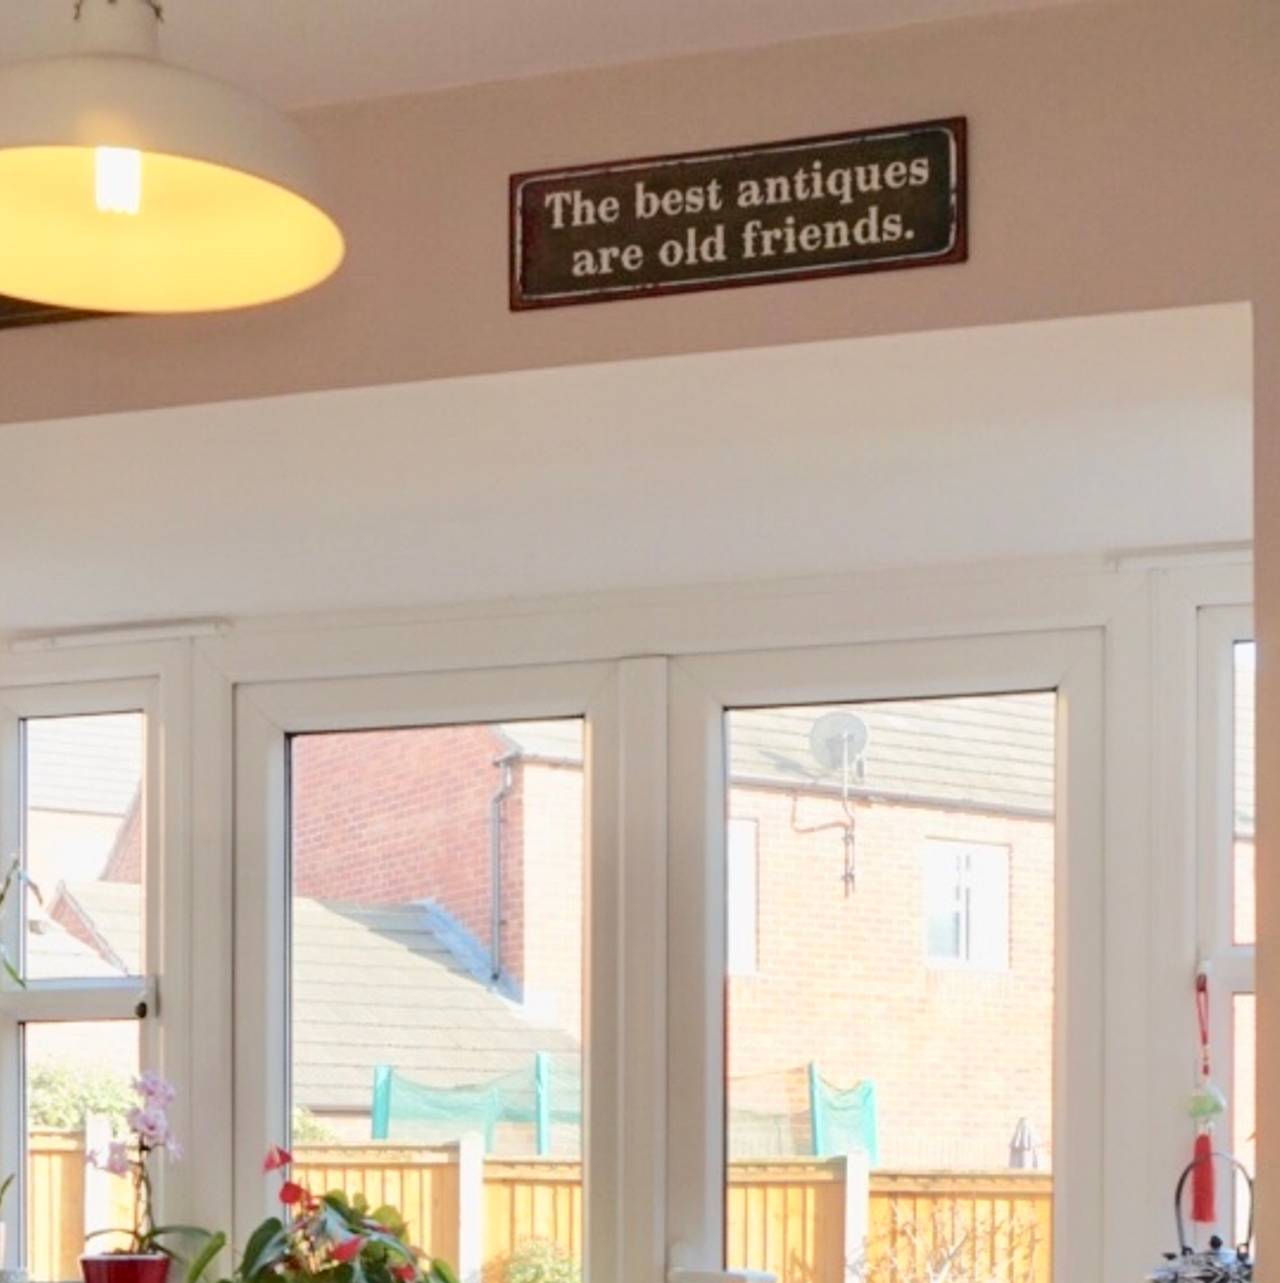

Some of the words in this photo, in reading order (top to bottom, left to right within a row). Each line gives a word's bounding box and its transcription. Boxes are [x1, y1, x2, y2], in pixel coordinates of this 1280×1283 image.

[544, 190, 620, 230] The
[634, 177, 723, 221] best
[736, 156, 931, 210] antiques
[571, 242, 645, 278] are
[658, 224, 728, 269] old
[740, 206, 917, 261] friends.
